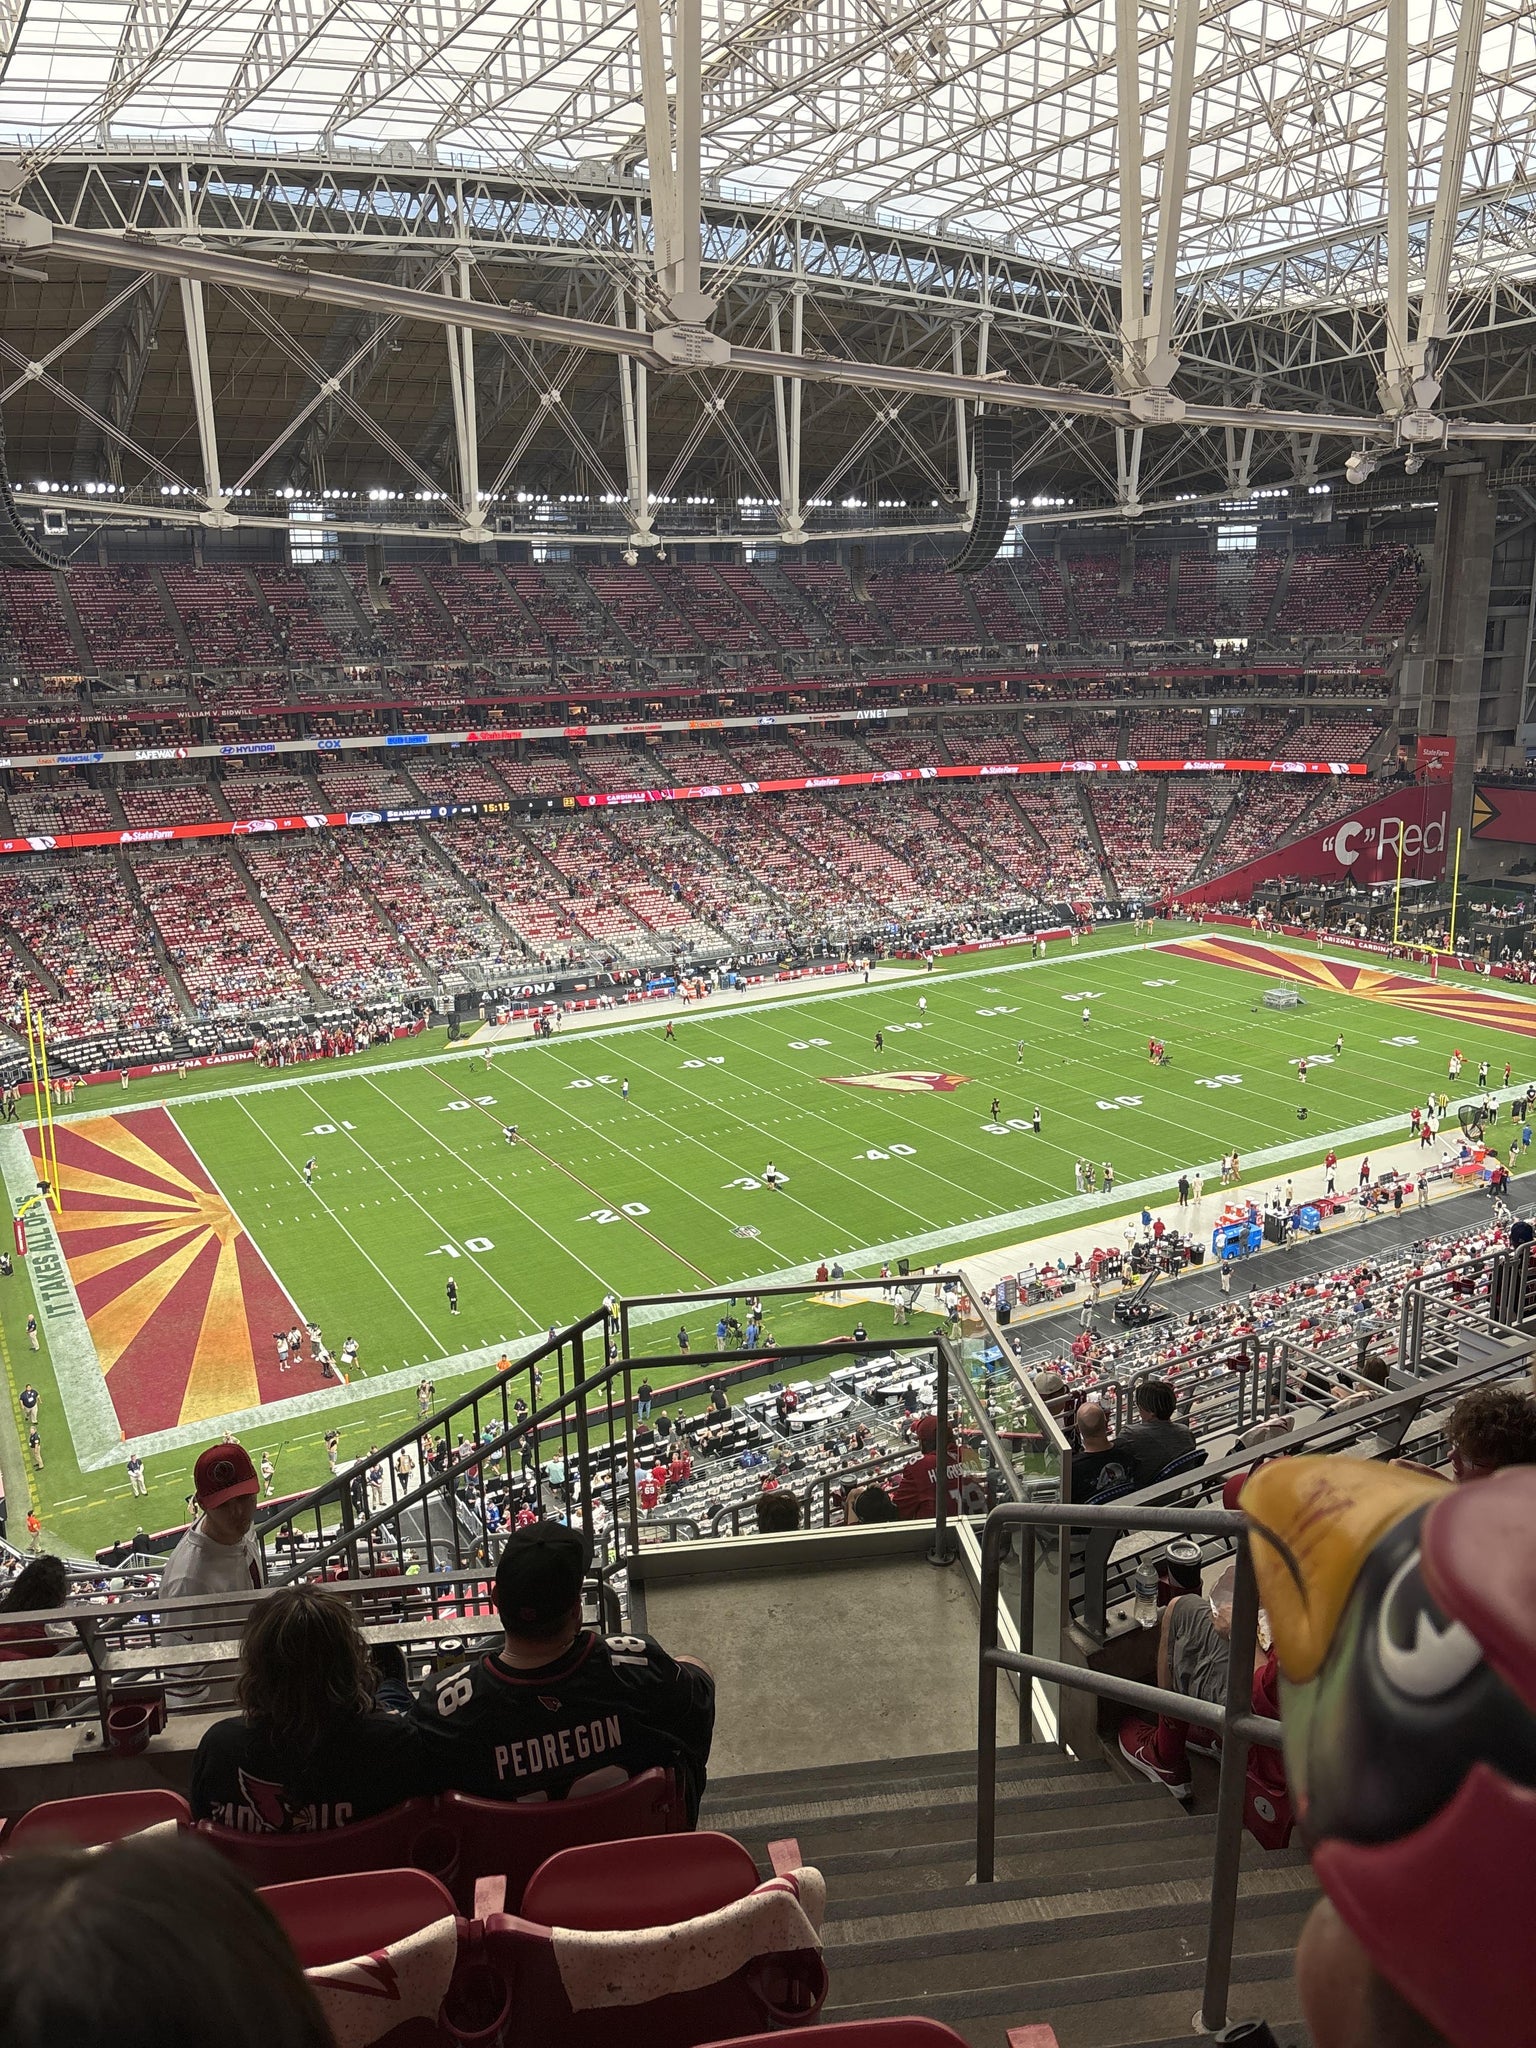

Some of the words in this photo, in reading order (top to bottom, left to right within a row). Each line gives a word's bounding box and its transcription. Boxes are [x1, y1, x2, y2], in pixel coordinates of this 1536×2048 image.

[28, 717, 66, 725] CHARLES
[177, 710, 211, 718] WILLIAM
[236, 744, 276, 753] HYUNDAI
[317, 740, 341, 749] COX
[135, 749, 176, 760] SAFEWAY
[387, 808, 431, 818] SEAHAWKS
[439, 806, 447, 816] 0
[483, 803, 510, 813] 15:15
[607, 793, 646, 801] CARDINALS
[1376, 811, 1447, 861] Red
[1323, 935, 1356, 947] ARIZONA
[1358, 941, 1400, 955] CARDINAS
[151, 1060, 202, 1073] ARIZNA
[206, 1051, 255, 1065] CARDINA
[1194, 1075, 1240, 1089] 30
[1095, 1096, 1139, 1111] 40
[980, 1118, 1035, 1135] 50
[866, 1143, 917, 1161] 40
[24, 1212, 48, 1227] OF
[589, 1201, 651, 1225] 20
[26, 1227, 57, 1253] ALL
[440, 1236, 495, 1259] 10
[31, 1253, 70, 1301] TAKES
[45, 1302, 77, 1319] IT
[494, 1714, 623, 1780] PEDREGON
